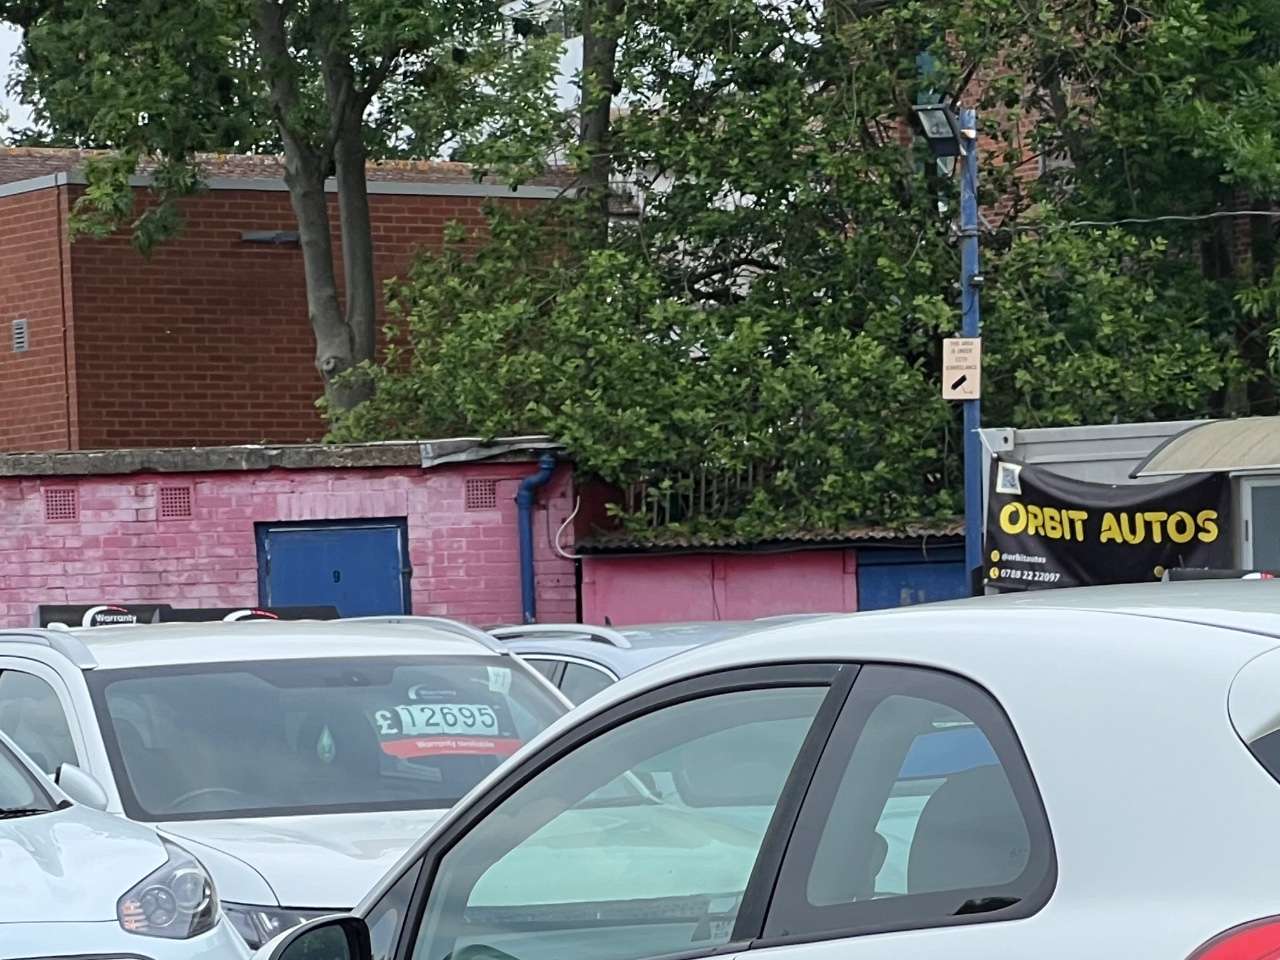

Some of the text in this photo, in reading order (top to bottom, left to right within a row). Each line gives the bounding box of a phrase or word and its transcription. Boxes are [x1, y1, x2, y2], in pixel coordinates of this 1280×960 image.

[999, 501, 1219, 544] ORBIT AUTOS
[332, 569, 341, 583] 9
[95, 614, 137, 625] Warranty
